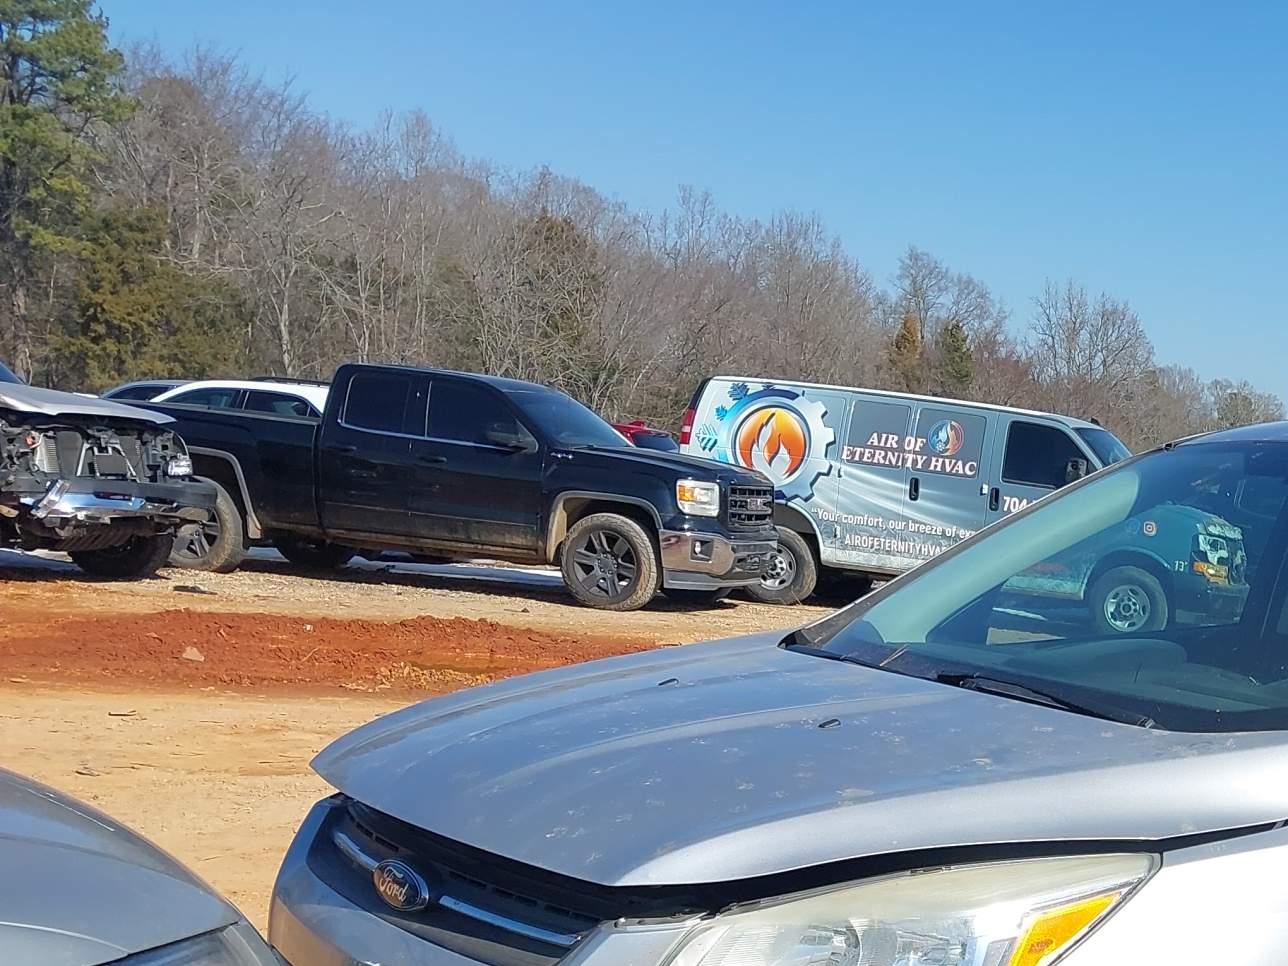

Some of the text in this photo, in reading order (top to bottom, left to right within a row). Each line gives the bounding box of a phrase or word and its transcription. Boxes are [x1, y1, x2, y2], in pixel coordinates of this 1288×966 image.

[867, 432, 927, 452] AIR OF
[841, 445, 977, 476] ETERNITY HVAC
[842, 513, 887, 530] comfort,
[889, 519, 907, 530] our
[908, 519, 943, 536] breeze
[945, 524, 957, 538] of
